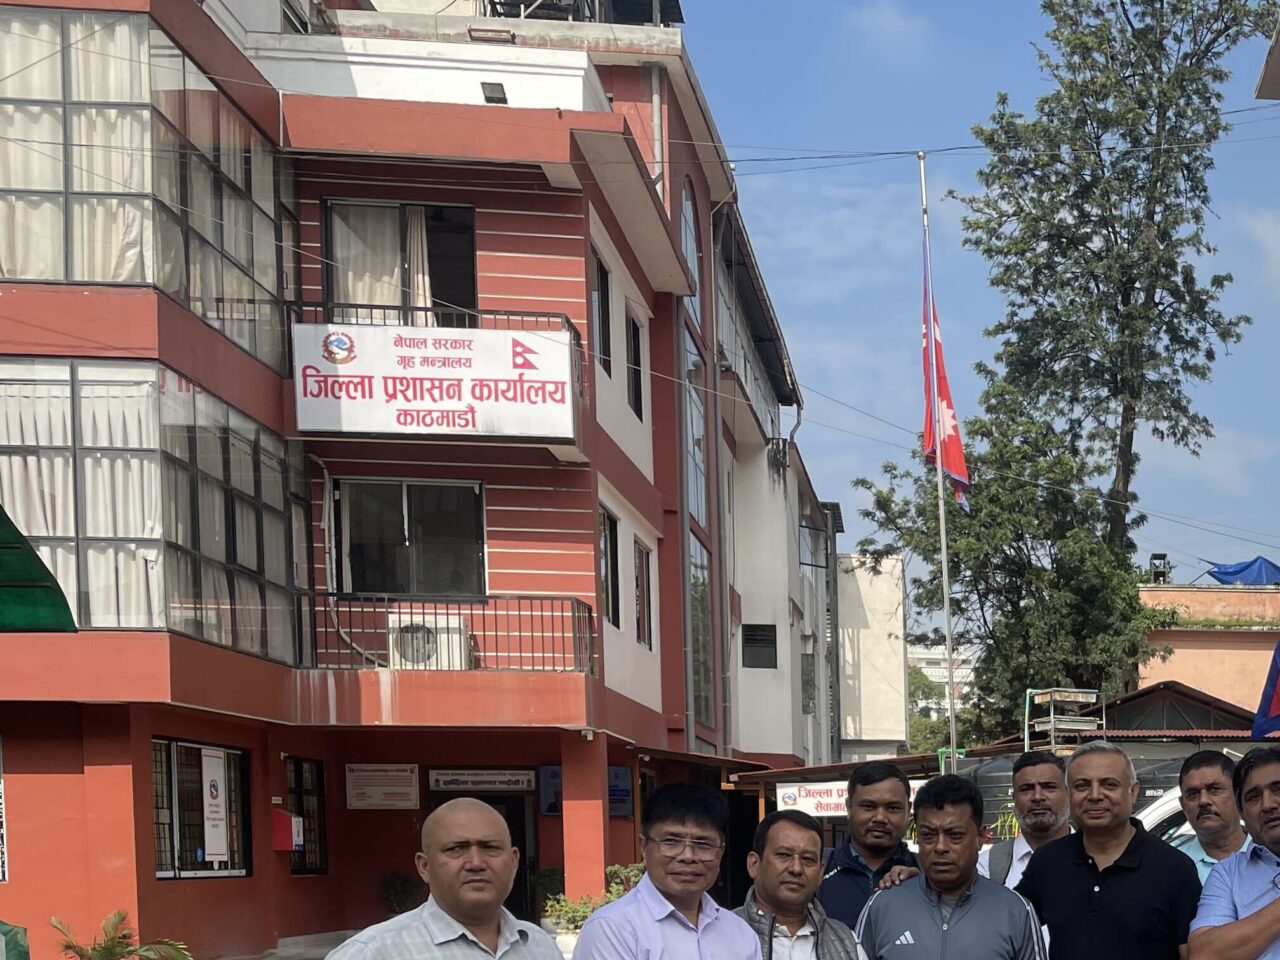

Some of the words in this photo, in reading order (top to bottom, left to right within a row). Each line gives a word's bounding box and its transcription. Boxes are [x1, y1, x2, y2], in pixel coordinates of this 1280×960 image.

[393, 333, 427, 350] नेपाल
[432, 337, 474, 351] सरकार
[397, 356, 415, 369] गृह
[420, 356, 472, 369] मन्त्रालय
[302, 365, 374, 400] जिल्ला
[383, 376, 463, 403] प्रशासन
[471, 373, 567, 404] कार्यालय
[798, 784, 833, 798] जिल्ला
